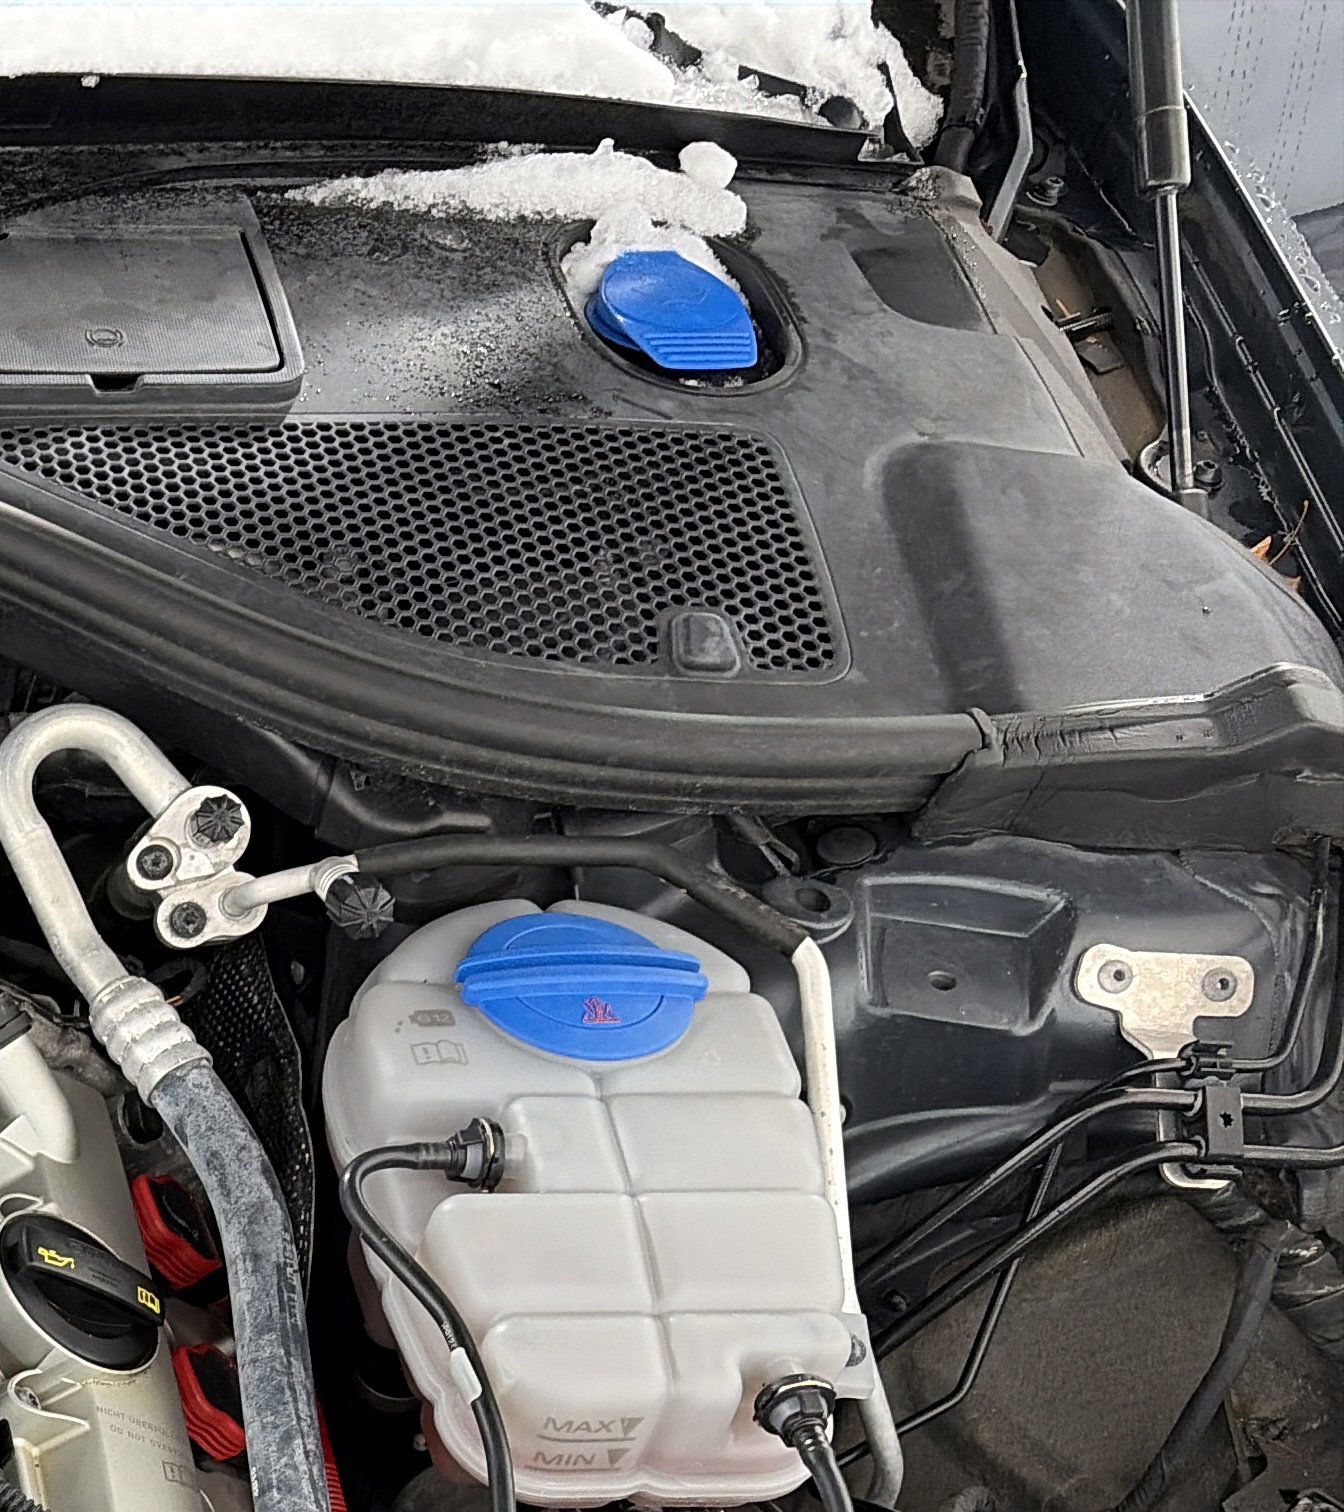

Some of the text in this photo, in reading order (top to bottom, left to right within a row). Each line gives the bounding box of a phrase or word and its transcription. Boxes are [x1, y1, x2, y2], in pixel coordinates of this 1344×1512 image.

[110, 1424, 123, 1434] DO
[128, 1432, 145, 1442] NOT
[542, 1417, 617, 1434] MAX
[532, 1451, 597, 1466] MIN
